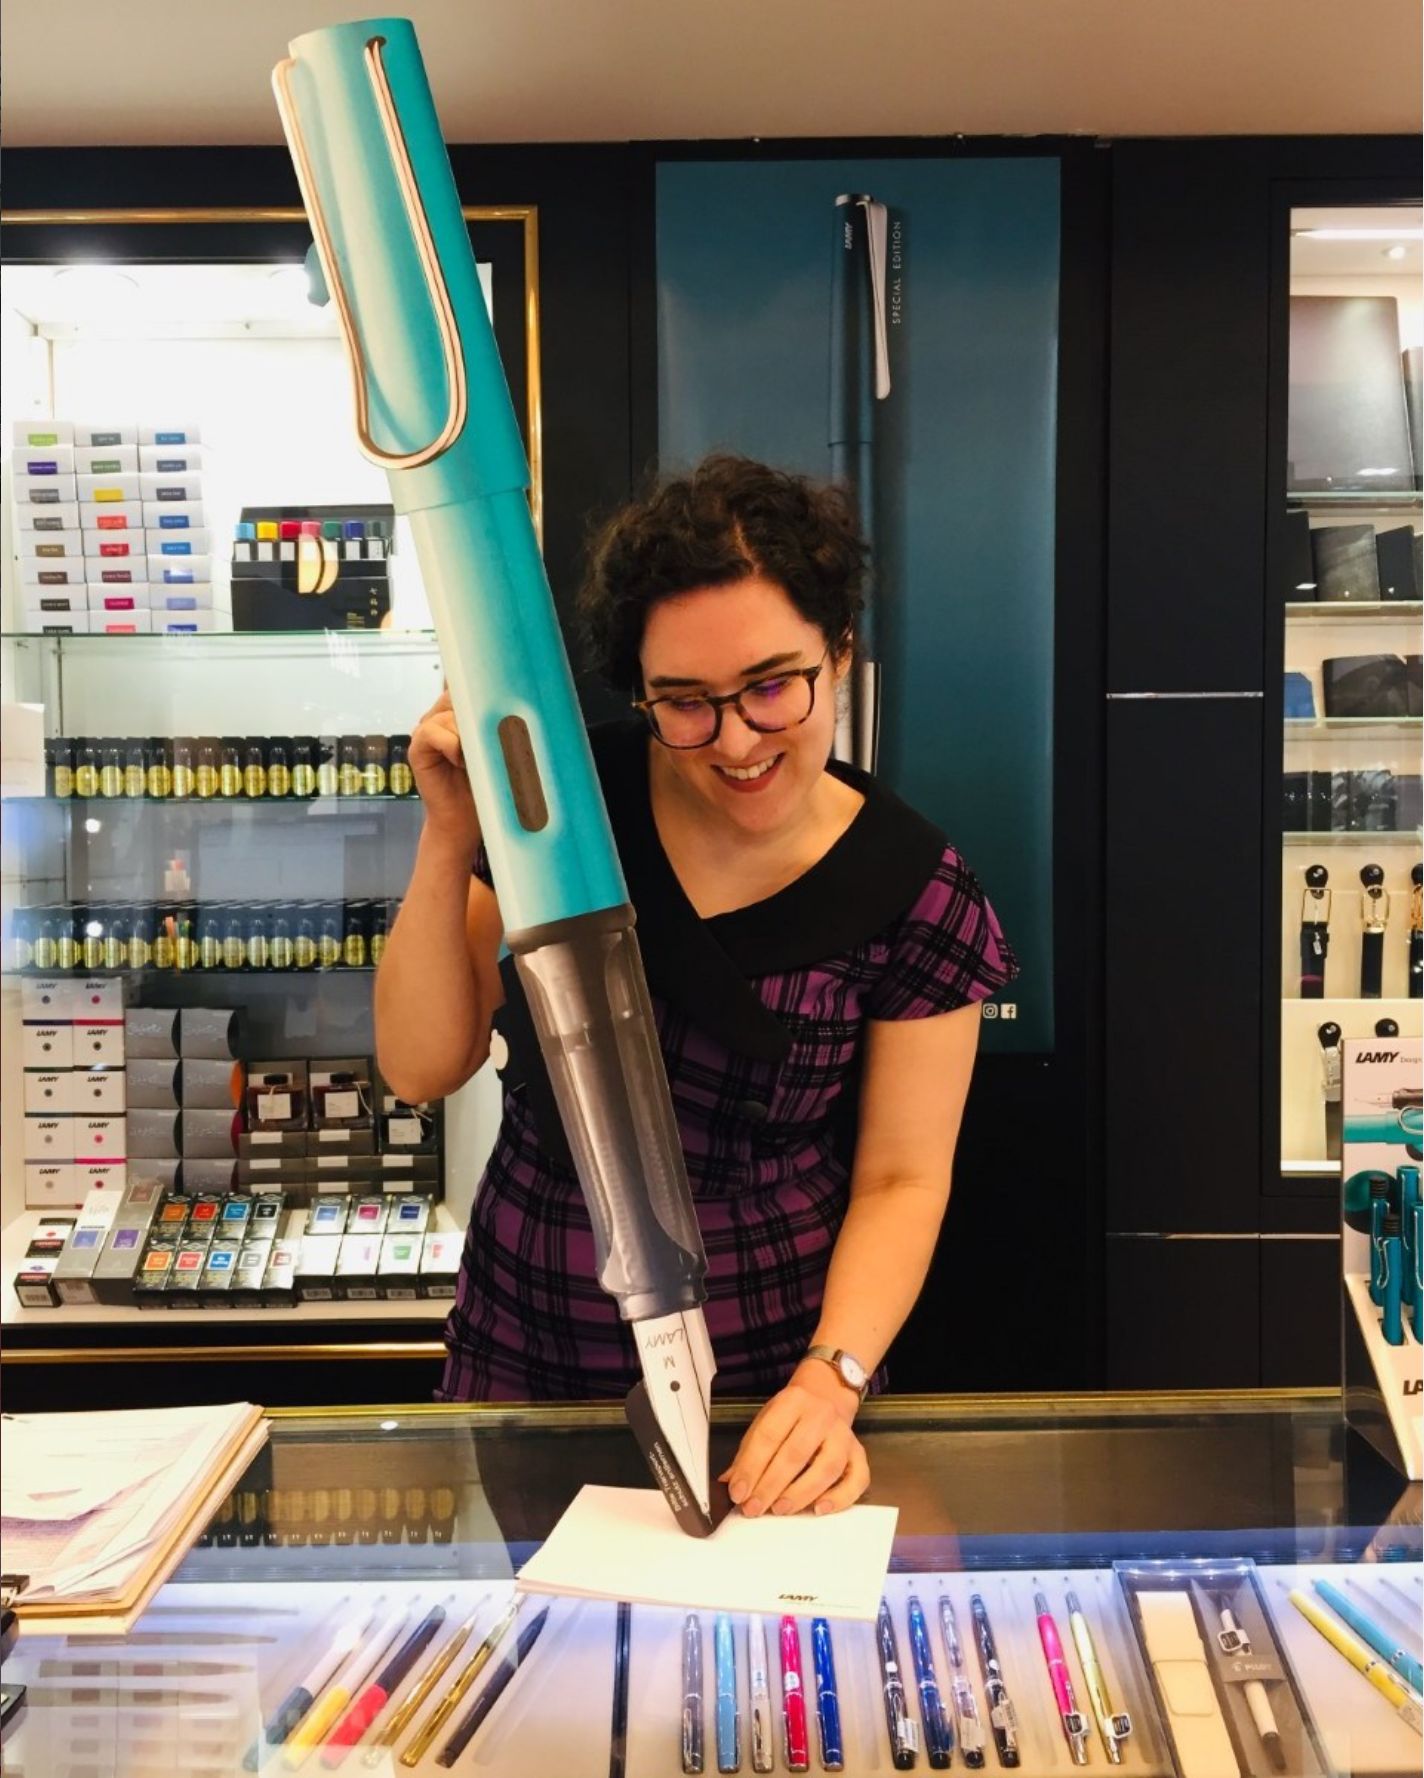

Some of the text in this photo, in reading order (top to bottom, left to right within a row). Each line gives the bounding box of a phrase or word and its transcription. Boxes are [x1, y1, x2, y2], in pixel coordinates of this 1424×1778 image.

[844, 222, 853, 250] LAMY
[892, 222, 901, 324] SPECIAL EDITION
[1355, 1051, 1400, 1064] LAMY
[644, 1327, 684, 1349] LAMY
[662, 1355, 677, 1370] M
[778, 1593, 818, 1602] LAMY
